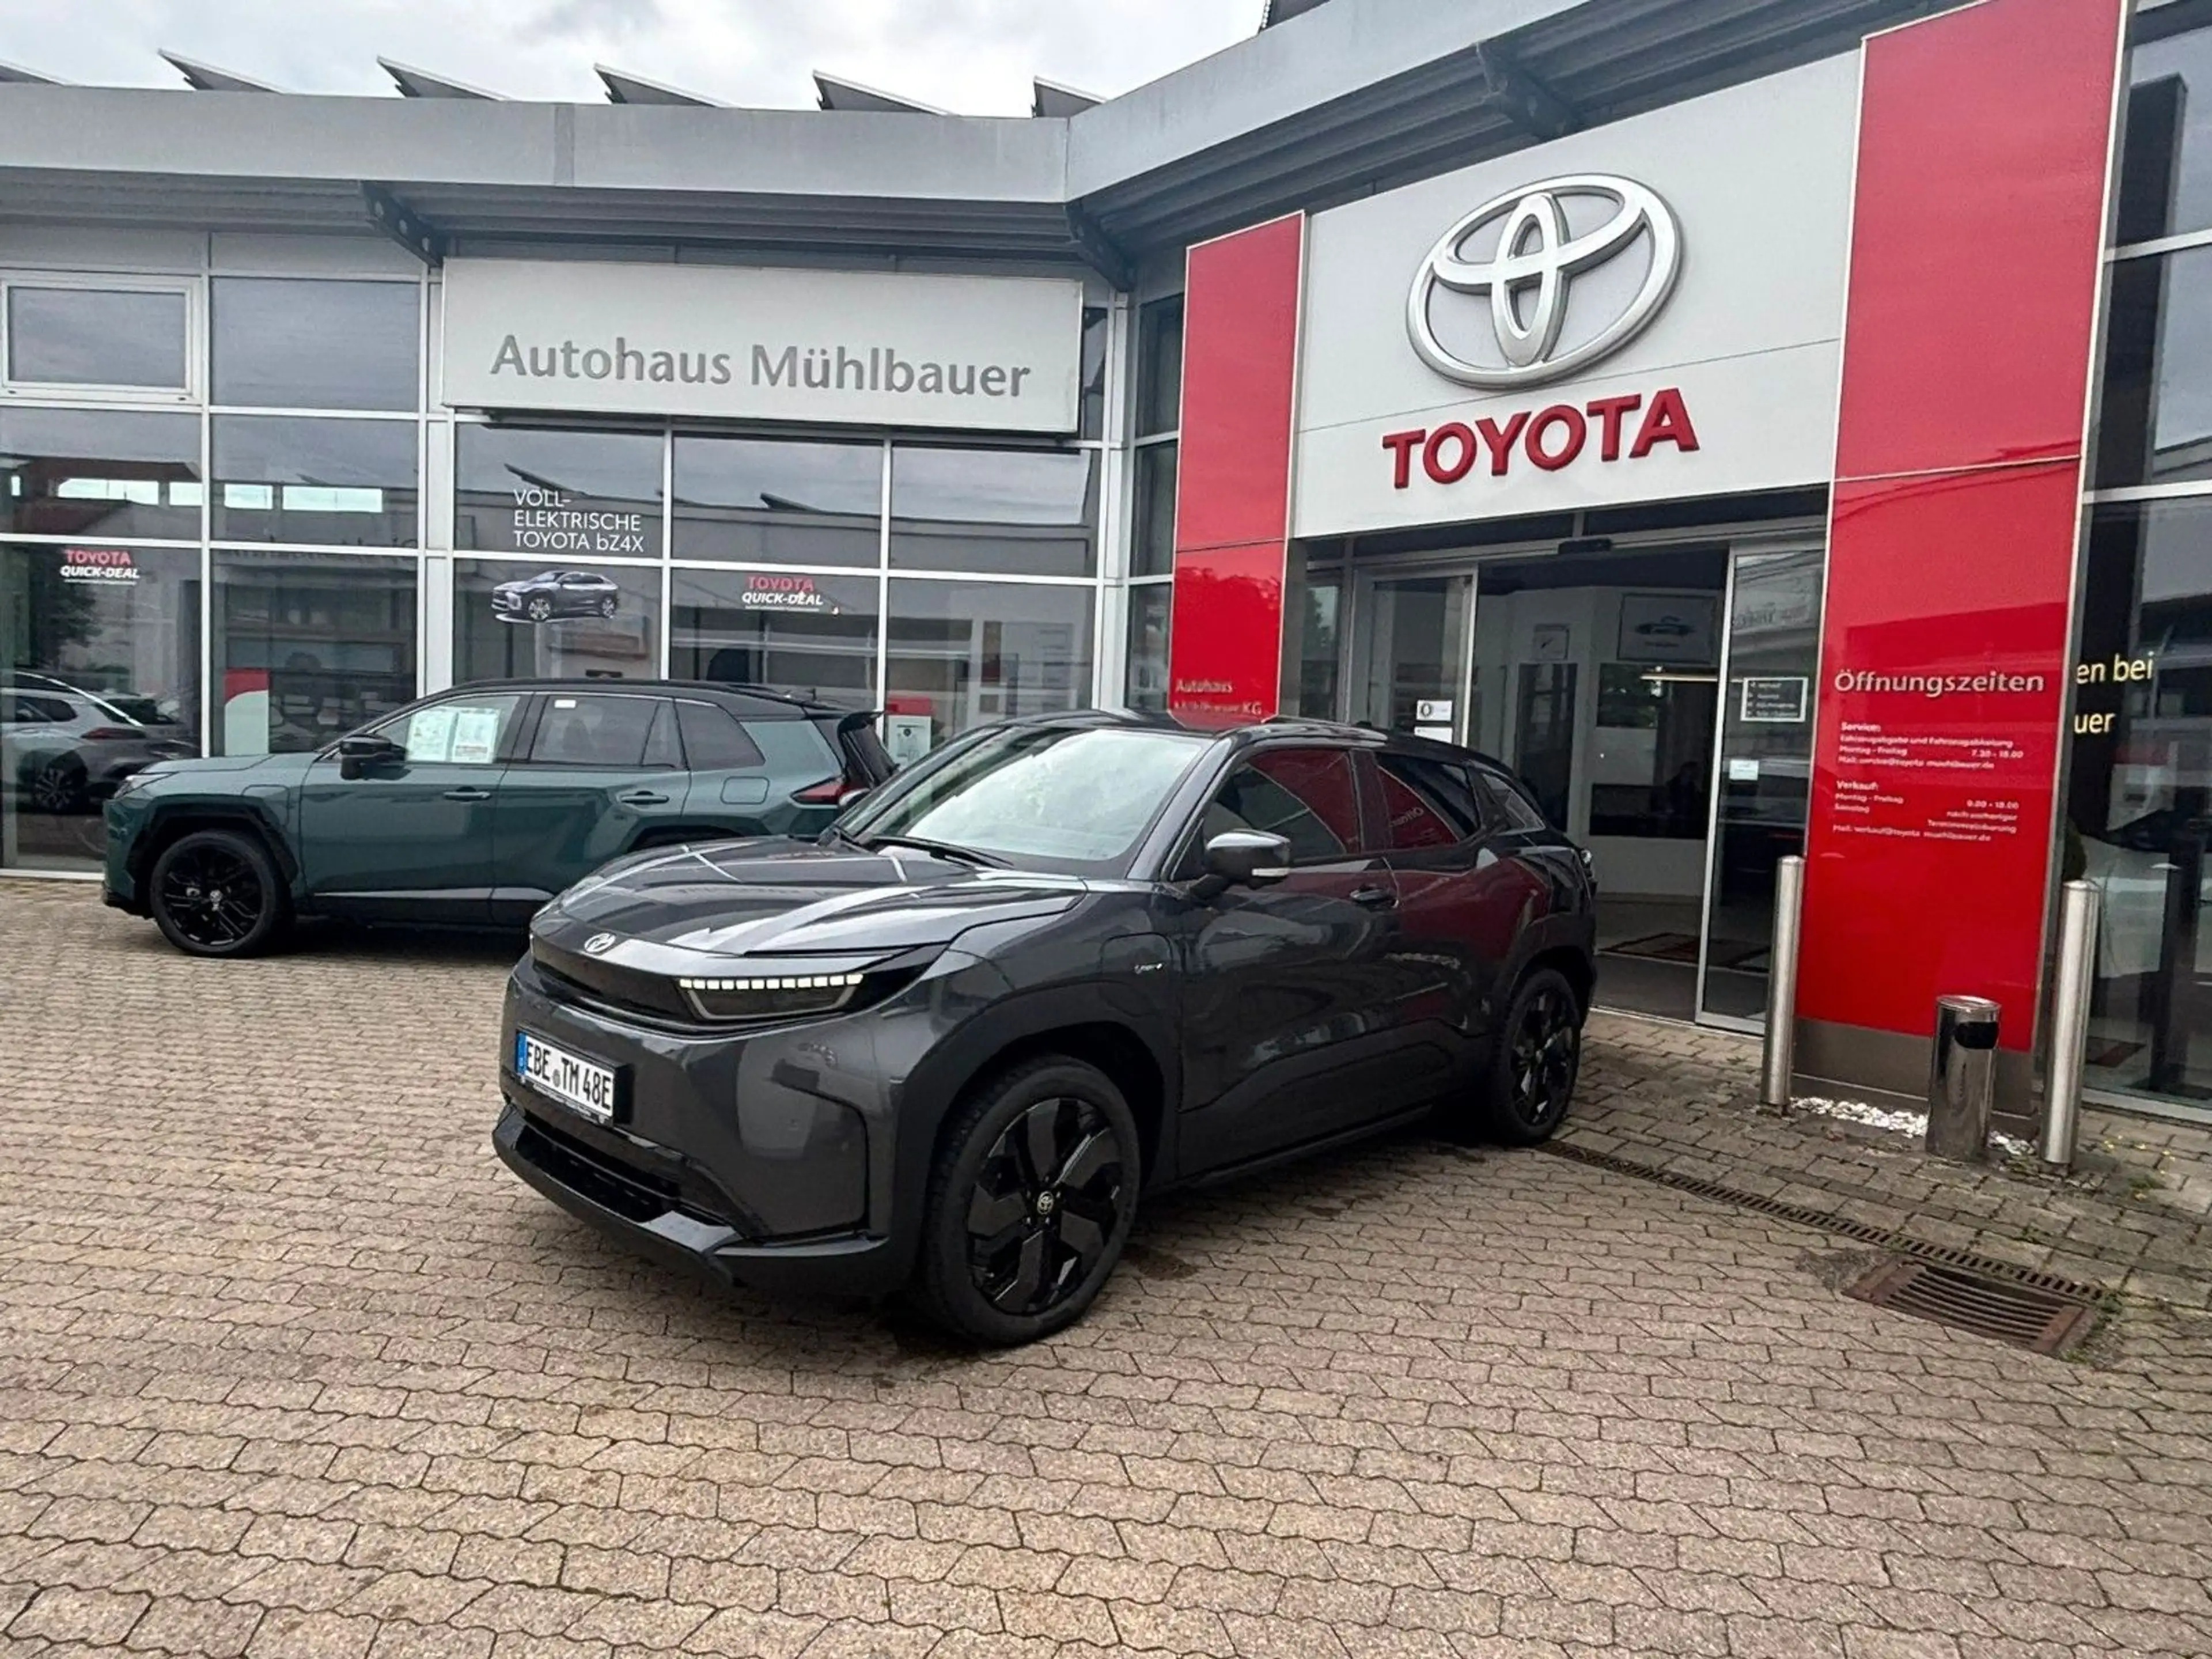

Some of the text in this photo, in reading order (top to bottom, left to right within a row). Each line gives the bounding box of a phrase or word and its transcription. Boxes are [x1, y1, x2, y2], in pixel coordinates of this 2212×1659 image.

[490, 334, 1031, 397] Autohaus Mühlbauer
[1382, 387, 1700, 489] TOYOTA
[513, 488, 572, 507] VOLL-
[514, 509, 642, 532] ELEKTRISCHE
[513, 530, 644, 553] TOYOTA bZ4X
[64, 548, 132, 566] TOYOTA
[59, 565, 141, 579] QUICK-DEAL
[748, 576, 815, 592] TOYOTA
[741, 590, 824, 605] QUICK-DEAL
[2113, 651, 2154, 682] bei
[1834, 669, 2044, 698] Öffnungszeiten
[527, 1041, 551, 1081] EBE
[561, 1056, 579, 1096] TM
[582, 1067, 611, 1111] 48E
